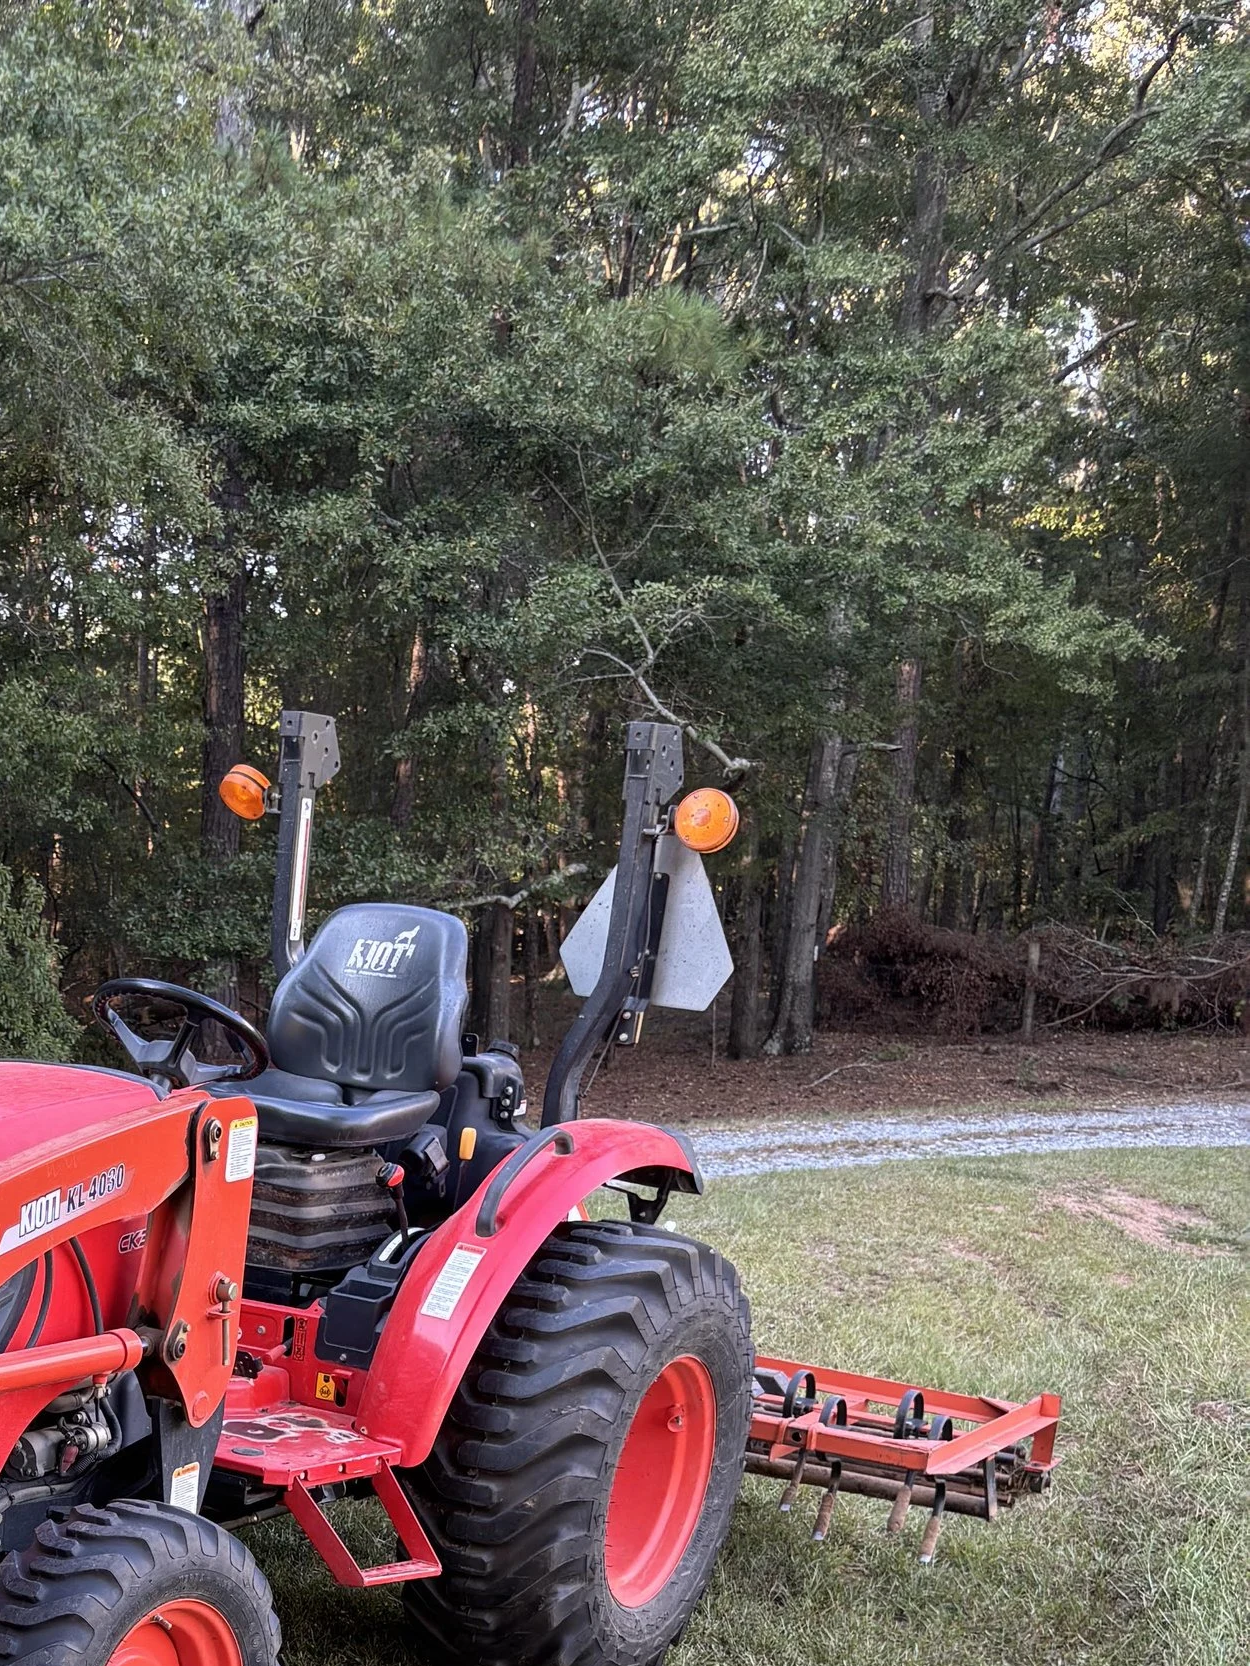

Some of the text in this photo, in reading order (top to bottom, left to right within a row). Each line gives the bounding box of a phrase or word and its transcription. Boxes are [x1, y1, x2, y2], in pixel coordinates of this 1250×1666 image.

[19, 1163, 125, 1237] KIOTI KL 4030
